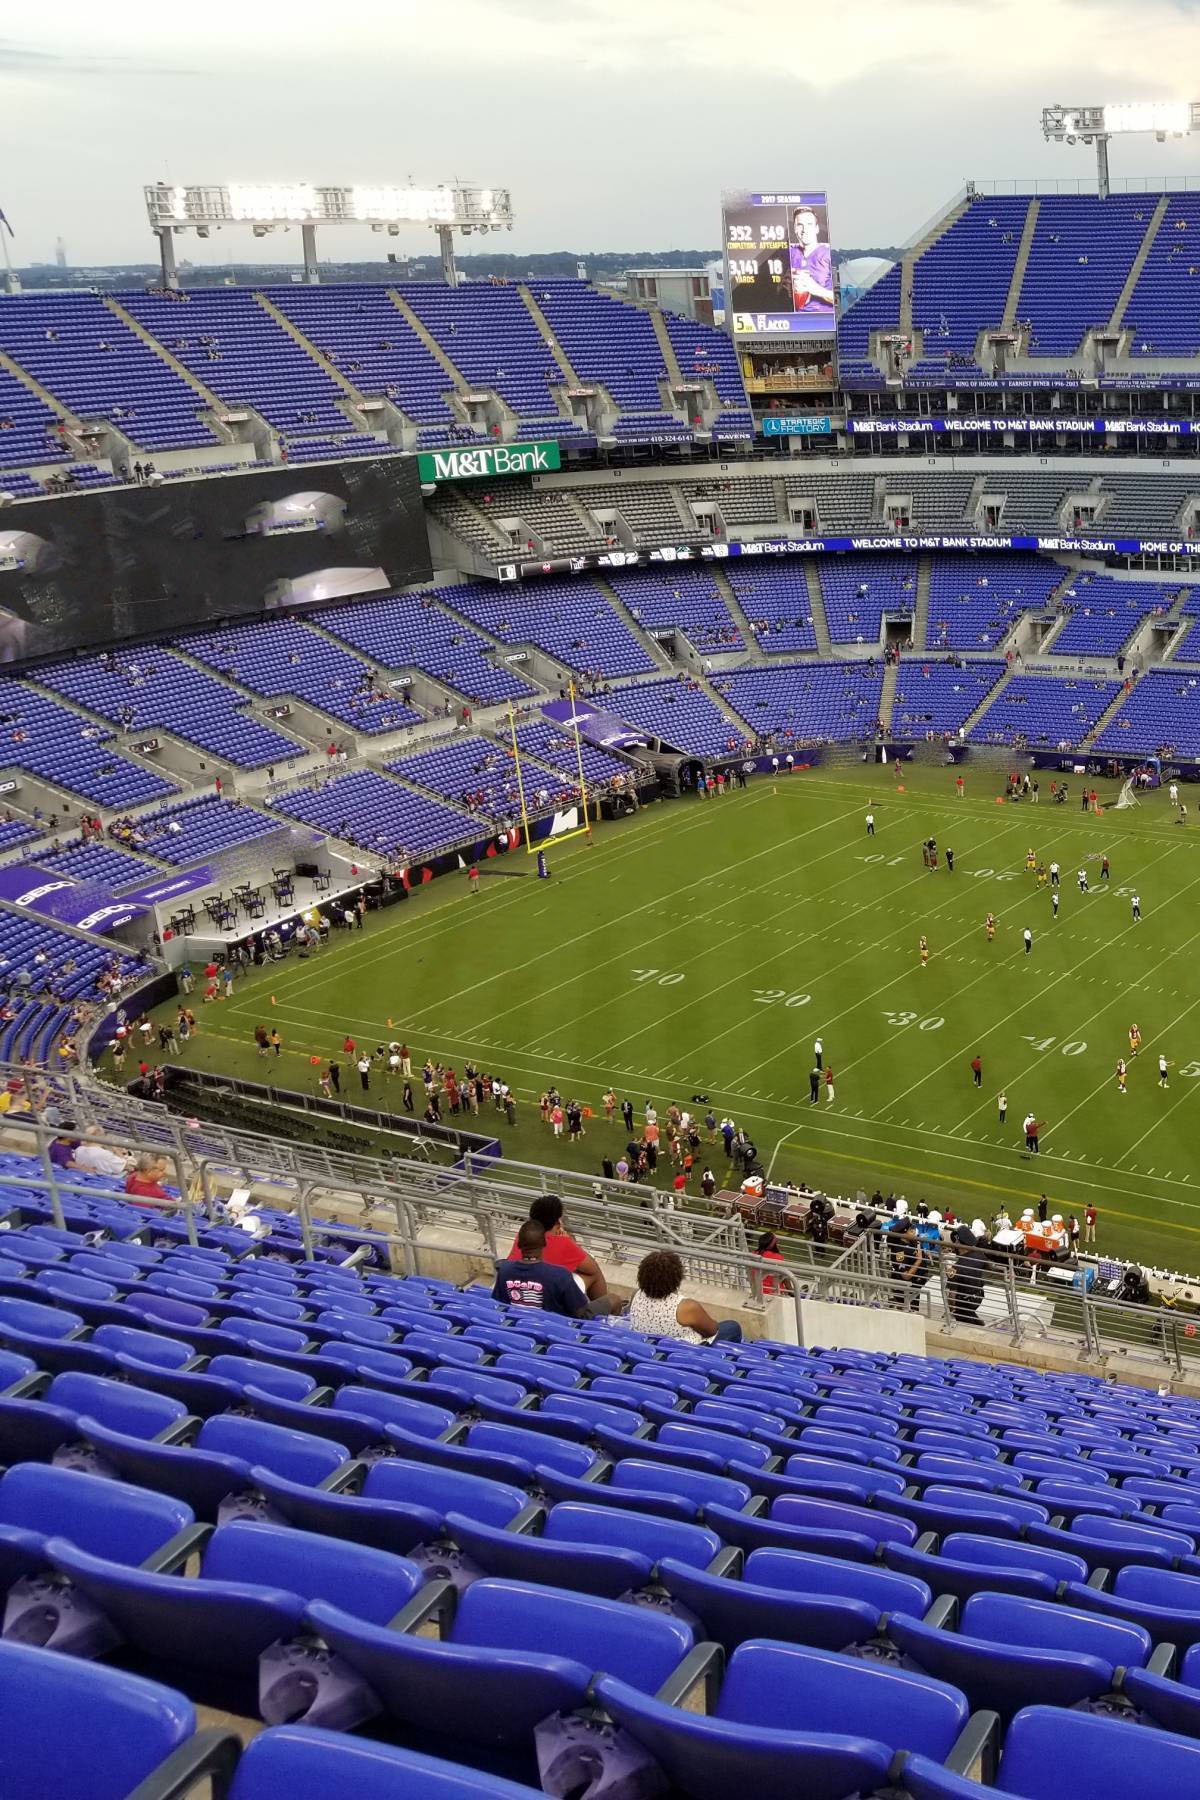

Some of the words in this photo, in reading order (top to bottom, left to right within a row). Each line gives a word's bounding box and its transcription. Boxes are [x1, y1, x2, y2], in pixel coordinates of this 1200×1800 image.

[729, 226, 752, 240] 352
[760, 226, 784, 240] 549
[729, 260, 758, 276] 3,141
[768, 259, 782, 274] 18
[735, 276, 755, 284] YARDS
[736, 316, 744, 330] 5
[853, 422, 876, 432] M&T
[876, 422, 897, 432] Bank
[898, 422, 932, 432] Stadium
[944, 420, 990, 432] WELCOME
[993, 420, 1006, 431] TO
[1008, 420, 1028, 431] M&T
[1029, 420, 1054, 431] BANK
[1056, 420, 1094, 431] STADIUM
[1104, 422, 1128, 433] M&T
[1128, 422, 1148, 433] Bank
[1148, 422, 1180, 434] Stadium
[432, 450, 492, 479] M&T
[493, 446, 549, 472] Bank
[741, 541, 764, 554] M&T
[764, 541, 788, 554] Bank
[788, 540, 824, 552] Stadium
[852, 538, 902, 550] WELCOME
[904, 538, 918, 548] TO
[920, 538, 940, 548] M&T
[943, 538, 967, 548] BANK
[969, 538, 1011, 548] STADIUM
[1038, 538, 1060, 550] M&T
[1060, 538, 1080, 550] Bank
[1081, 539, 1115, 552] Stadium
[1140, 542, 1168, 552] HOME
[1169, 542, 1183, 553] OF
[864, 854, 906, 866] 10
[974, 868, 1021, 881] 20
[15, 880, 76, 906] GEICO
[1088, 884, 1136, 898] 30
[76, 904, 136, 930] GEICO
[633, 970, 685, 986] 10
[758, 990, 812, 1008] 20
[889, 1010, 946, 1032] 30
[1032, 1036, 1088, 1056] 40
